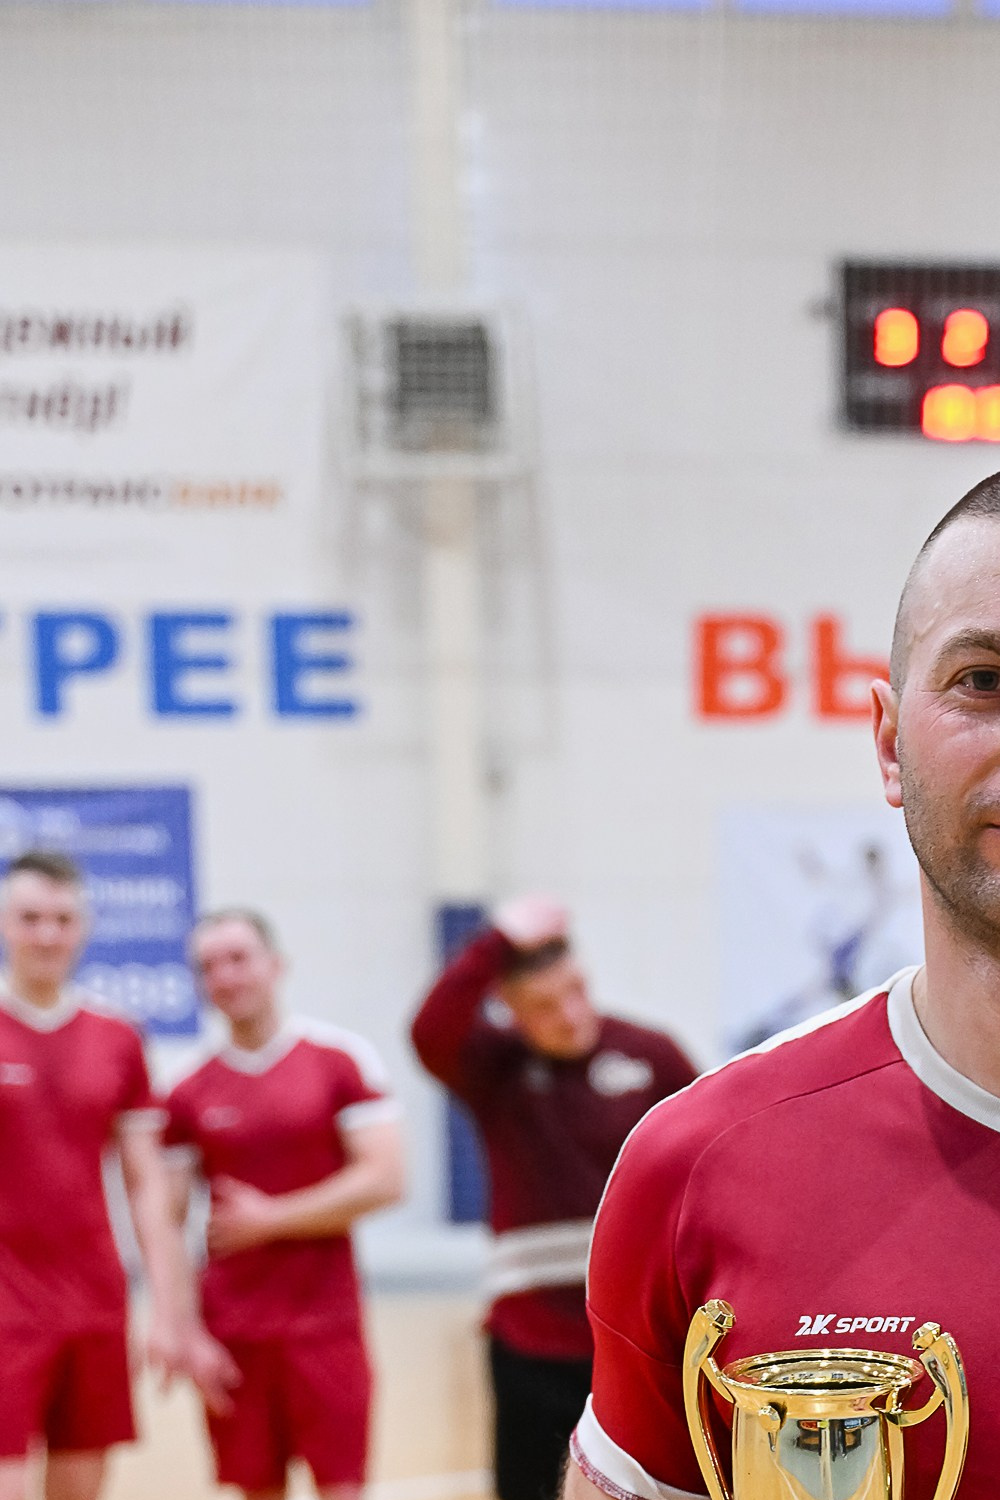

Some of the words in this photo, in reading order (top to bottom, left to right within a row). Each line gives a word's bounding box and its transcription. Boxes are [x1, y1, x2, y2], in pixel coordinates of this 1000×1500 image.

[0, 609, 360, 719] РЕЕ
[795, 1314, 837, 1336] 2K
[834, 1316, 916, 1334] SPORT
